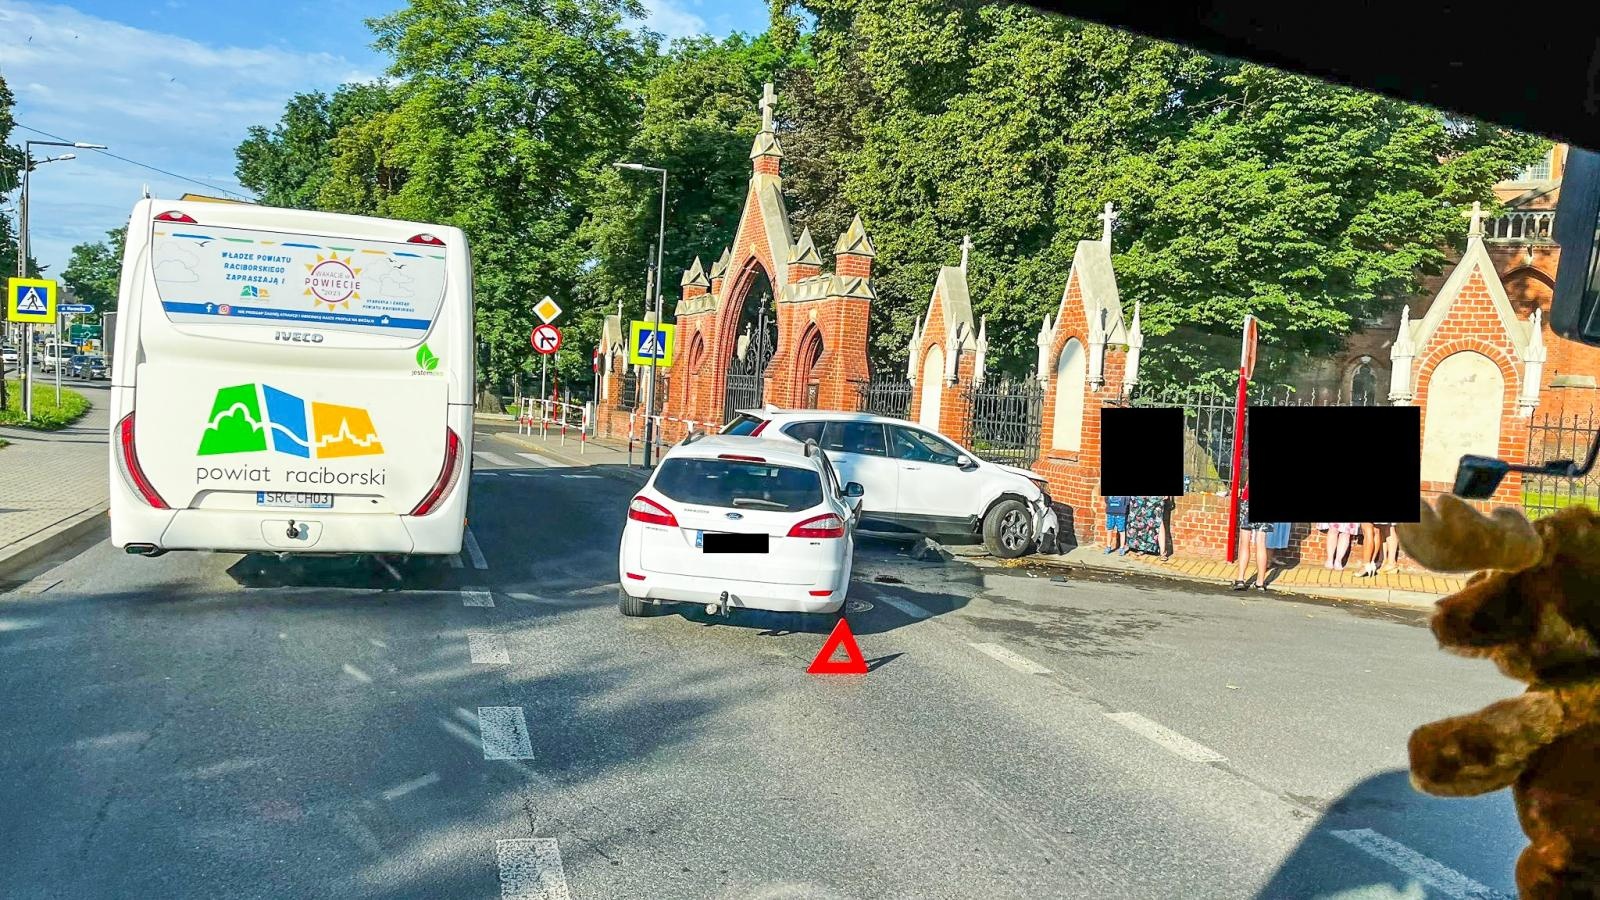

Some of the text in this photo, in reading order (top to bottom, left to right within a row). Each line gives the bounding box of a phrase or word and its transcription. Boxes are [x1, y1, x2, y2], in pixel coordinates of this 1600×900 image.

[222, 252, 292, 263] WŁADZE POWIATU
[224, 262, 285, 273] RACIBORSKIEGO
[226, 274, 279, 285] ZAPRASZAJĄ
[305, 277, 361, 290] POWIECIE
[274, 331, 324, 343] IVECO
[196, 463, 386, 486] powiat raciborski
[266, 491, 291, 503] SRC
[296, 492, 329, 504] CH03
